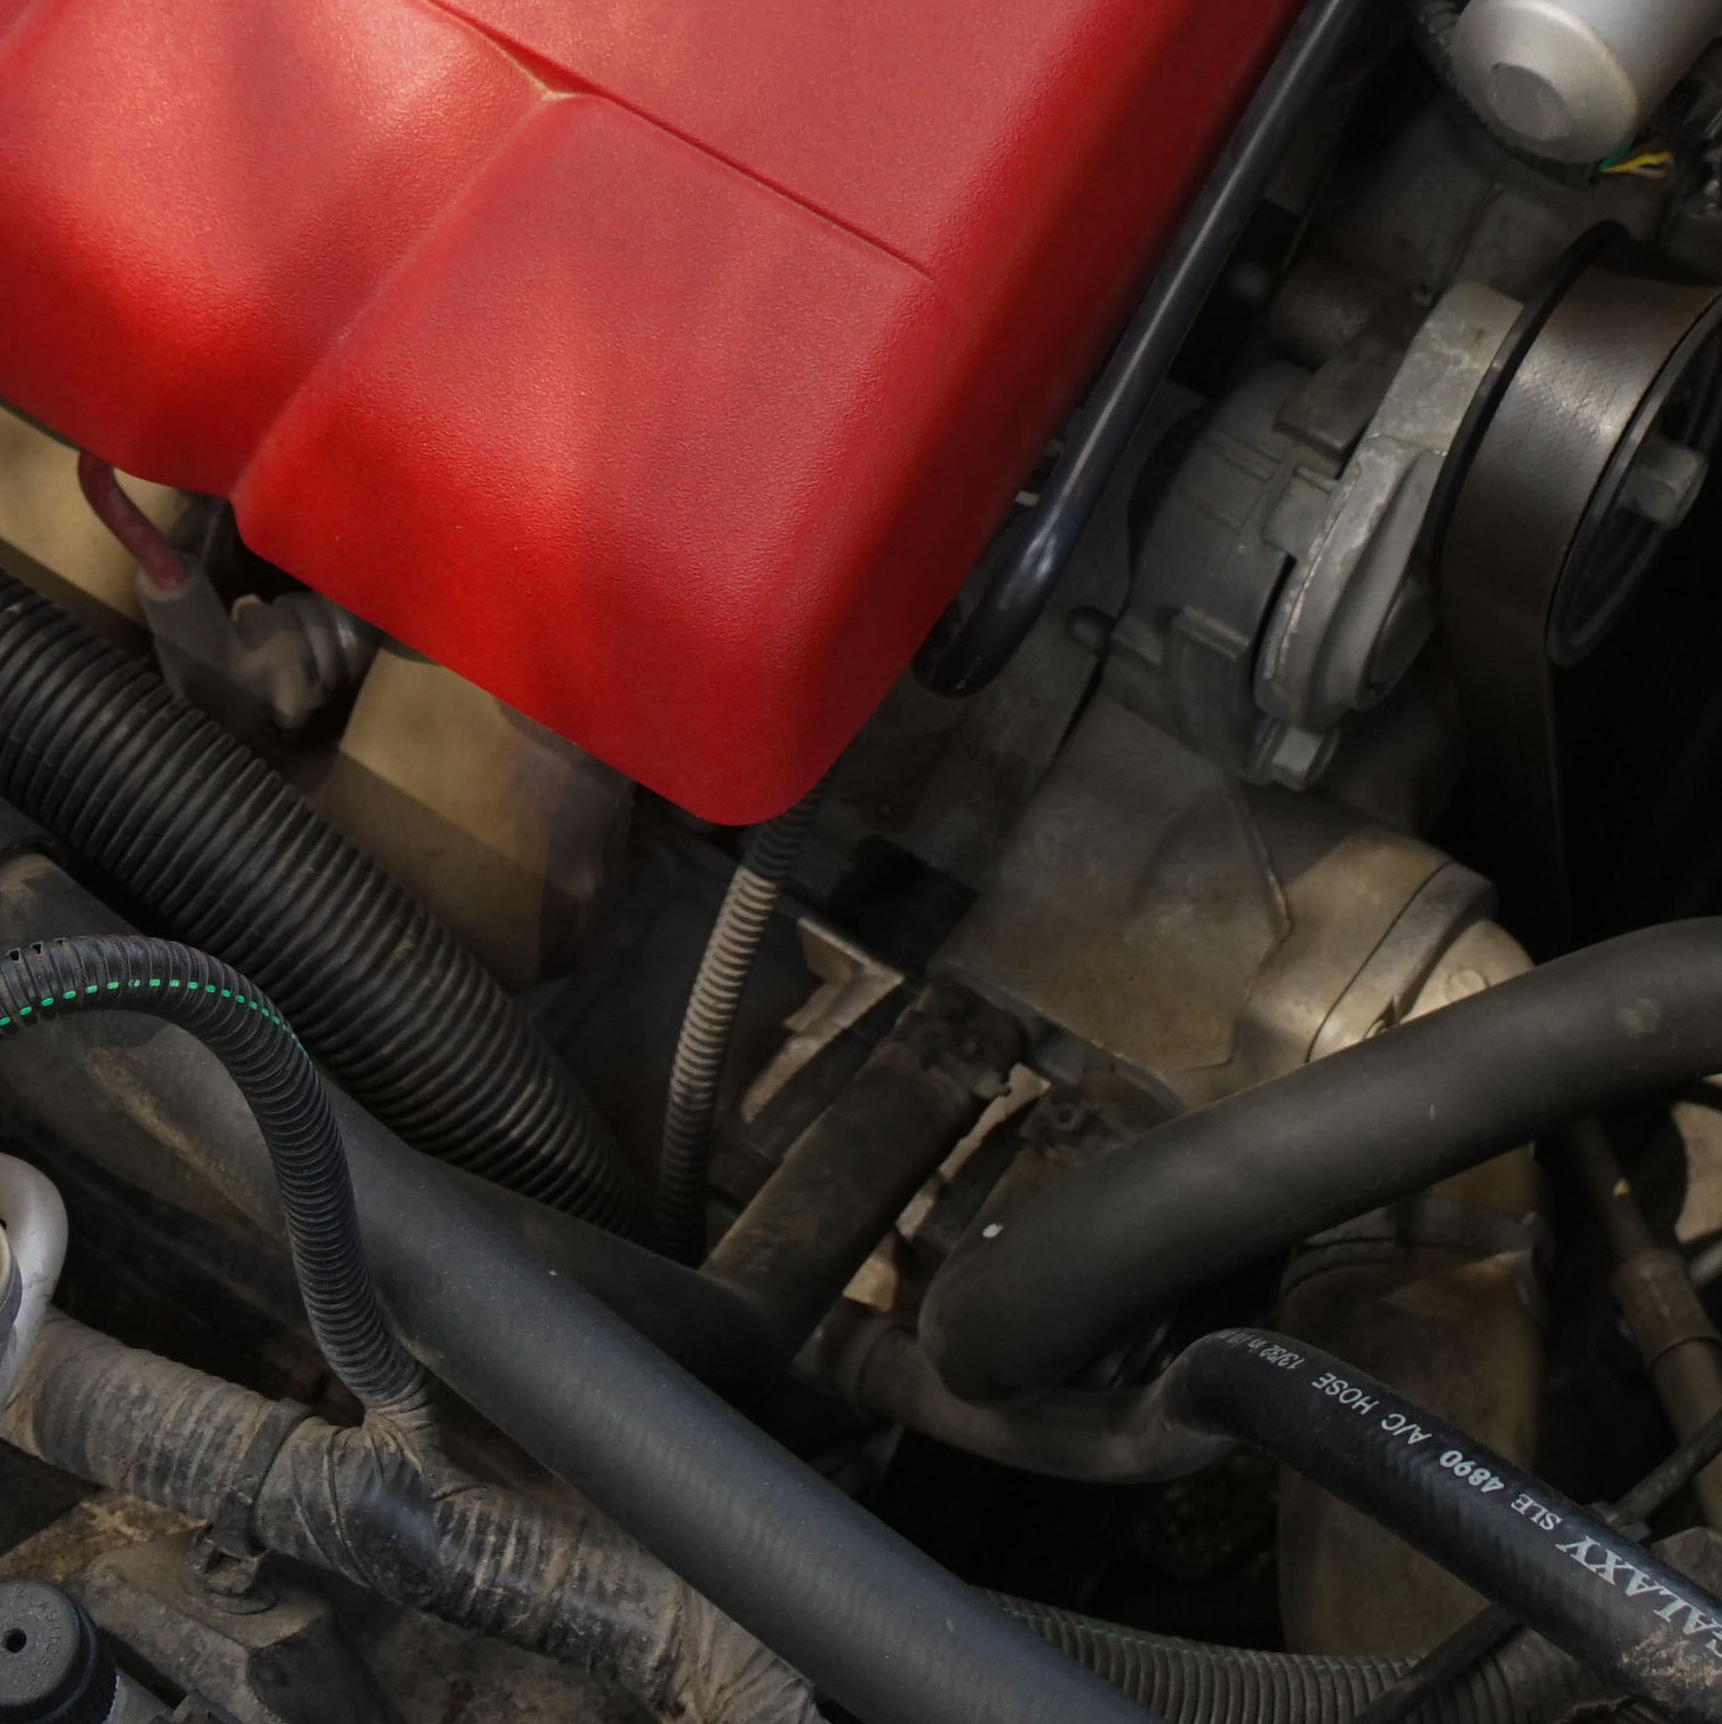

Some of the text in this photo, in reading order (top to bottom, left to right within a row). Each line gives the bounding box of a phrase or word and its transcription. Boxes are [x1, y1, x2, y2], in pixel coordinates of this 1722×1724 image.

[1257, 1343, 1305, 1371] 13/32
[1311, 1372, 1380, 1416] HOSE
[1380, 1412, 1433, 1446] A/C
[1439, 1449, 1505, 1494] 4890
[1510, 1492, 1563, 1531] SLE
